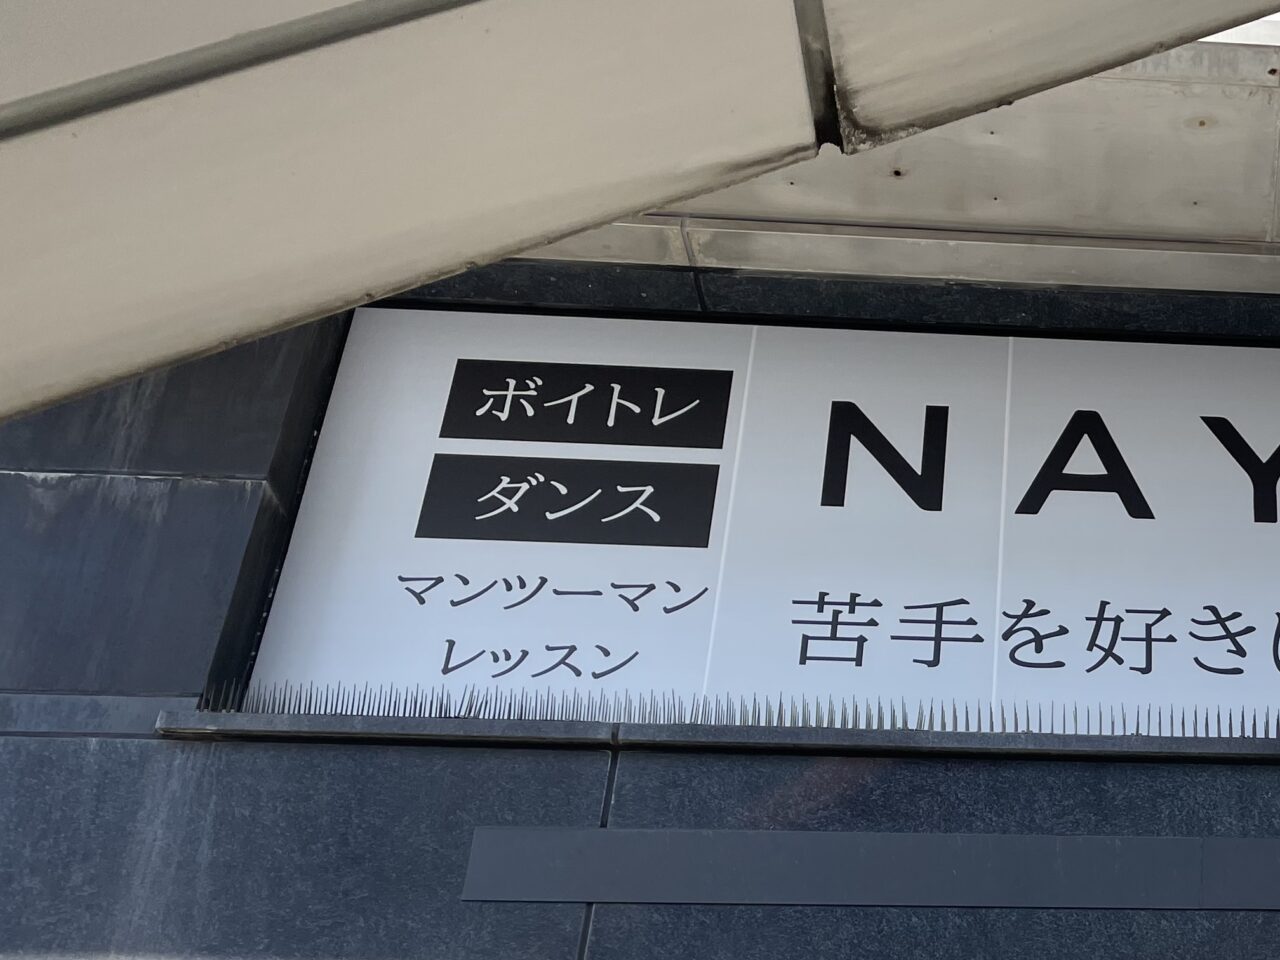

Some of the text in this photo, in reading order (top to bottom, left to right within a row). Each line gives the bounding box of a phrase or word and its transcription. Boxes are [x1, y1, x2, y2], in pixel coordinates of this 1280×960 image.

[474, 376, 701, 429] ボイトレ
[474, 474, 662, 523] ダンス
[396, 573, 709, 615] マンツーマン
[440, 638, 639, 679] レッスン
